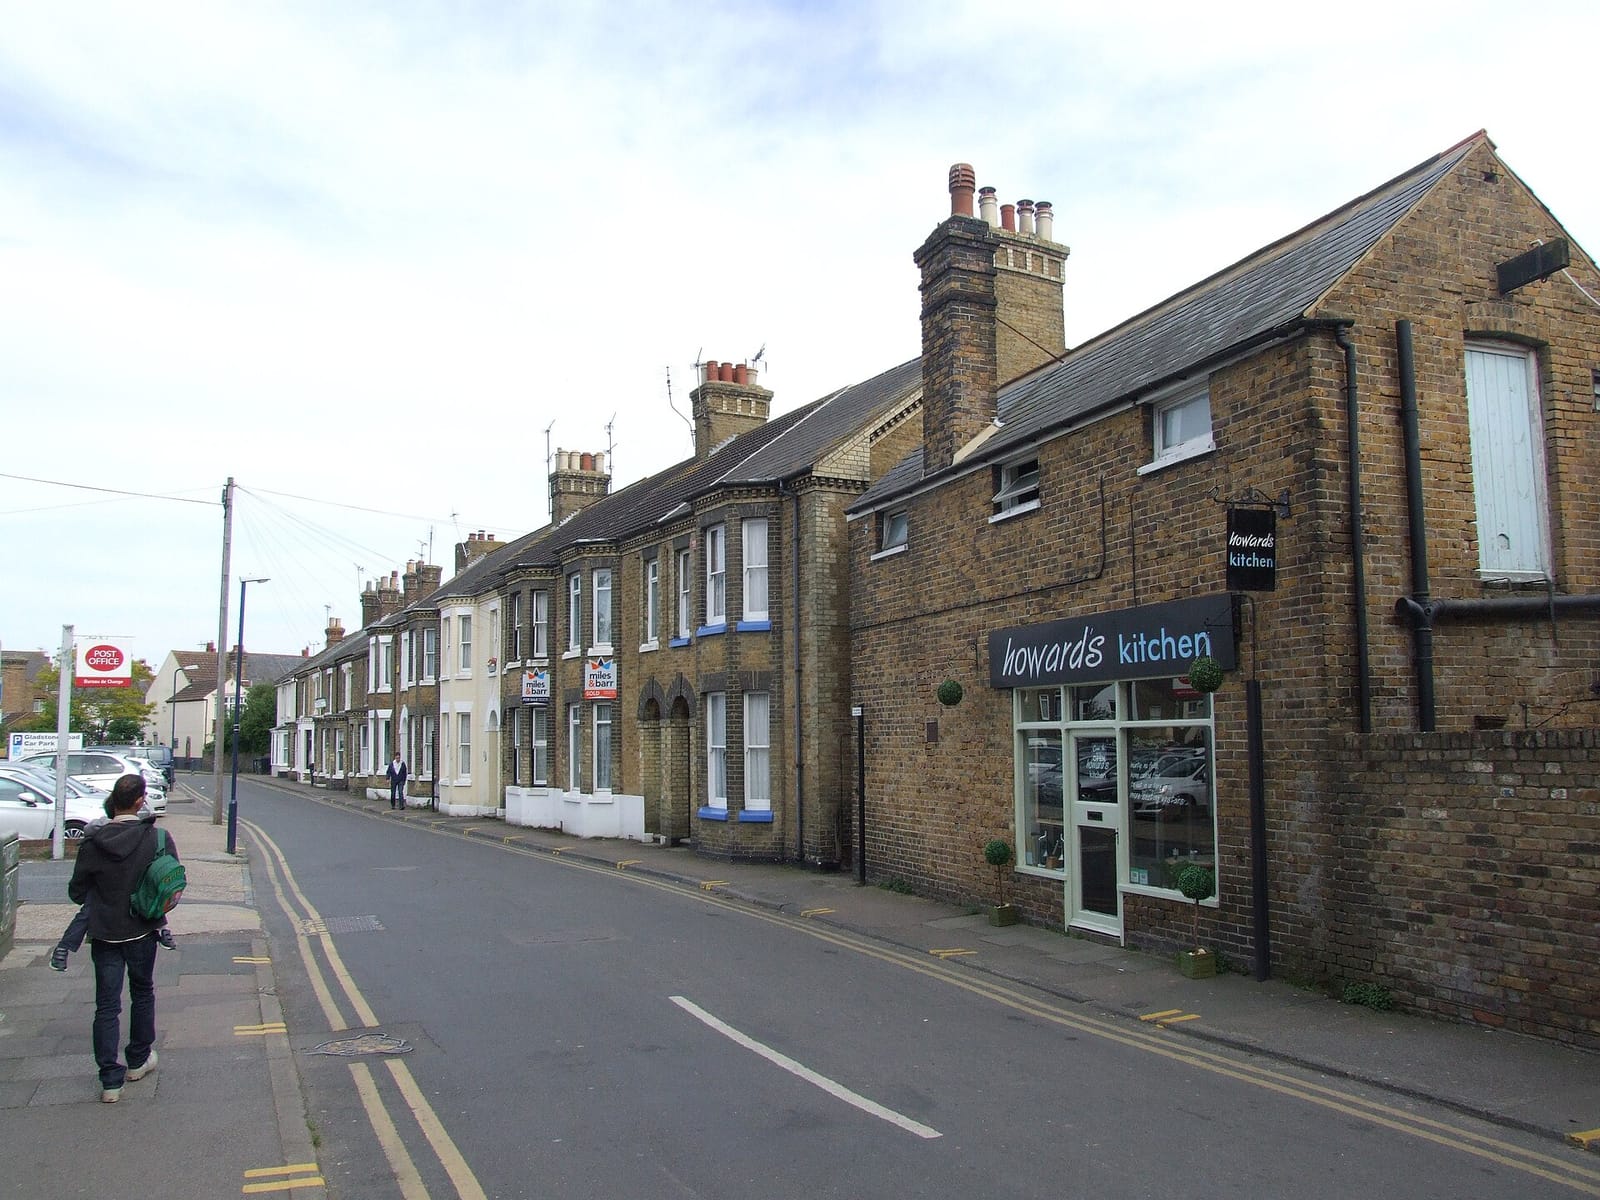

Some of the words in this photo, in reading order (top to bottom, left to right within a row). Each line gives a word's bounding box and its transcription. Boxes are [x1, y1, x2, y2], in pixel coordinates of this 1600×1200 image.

[1229, 551, 1273, 568] kitchen
[94, 650, 117, 658] POST
[1002, 625, 1105, 679] howard's
[1118, 627, 1211, 665] kitchen
[88, 657, 120, 665] OFFICE
[589, 671, 612, 679] miles
[526, 680, 545, 688] miles
